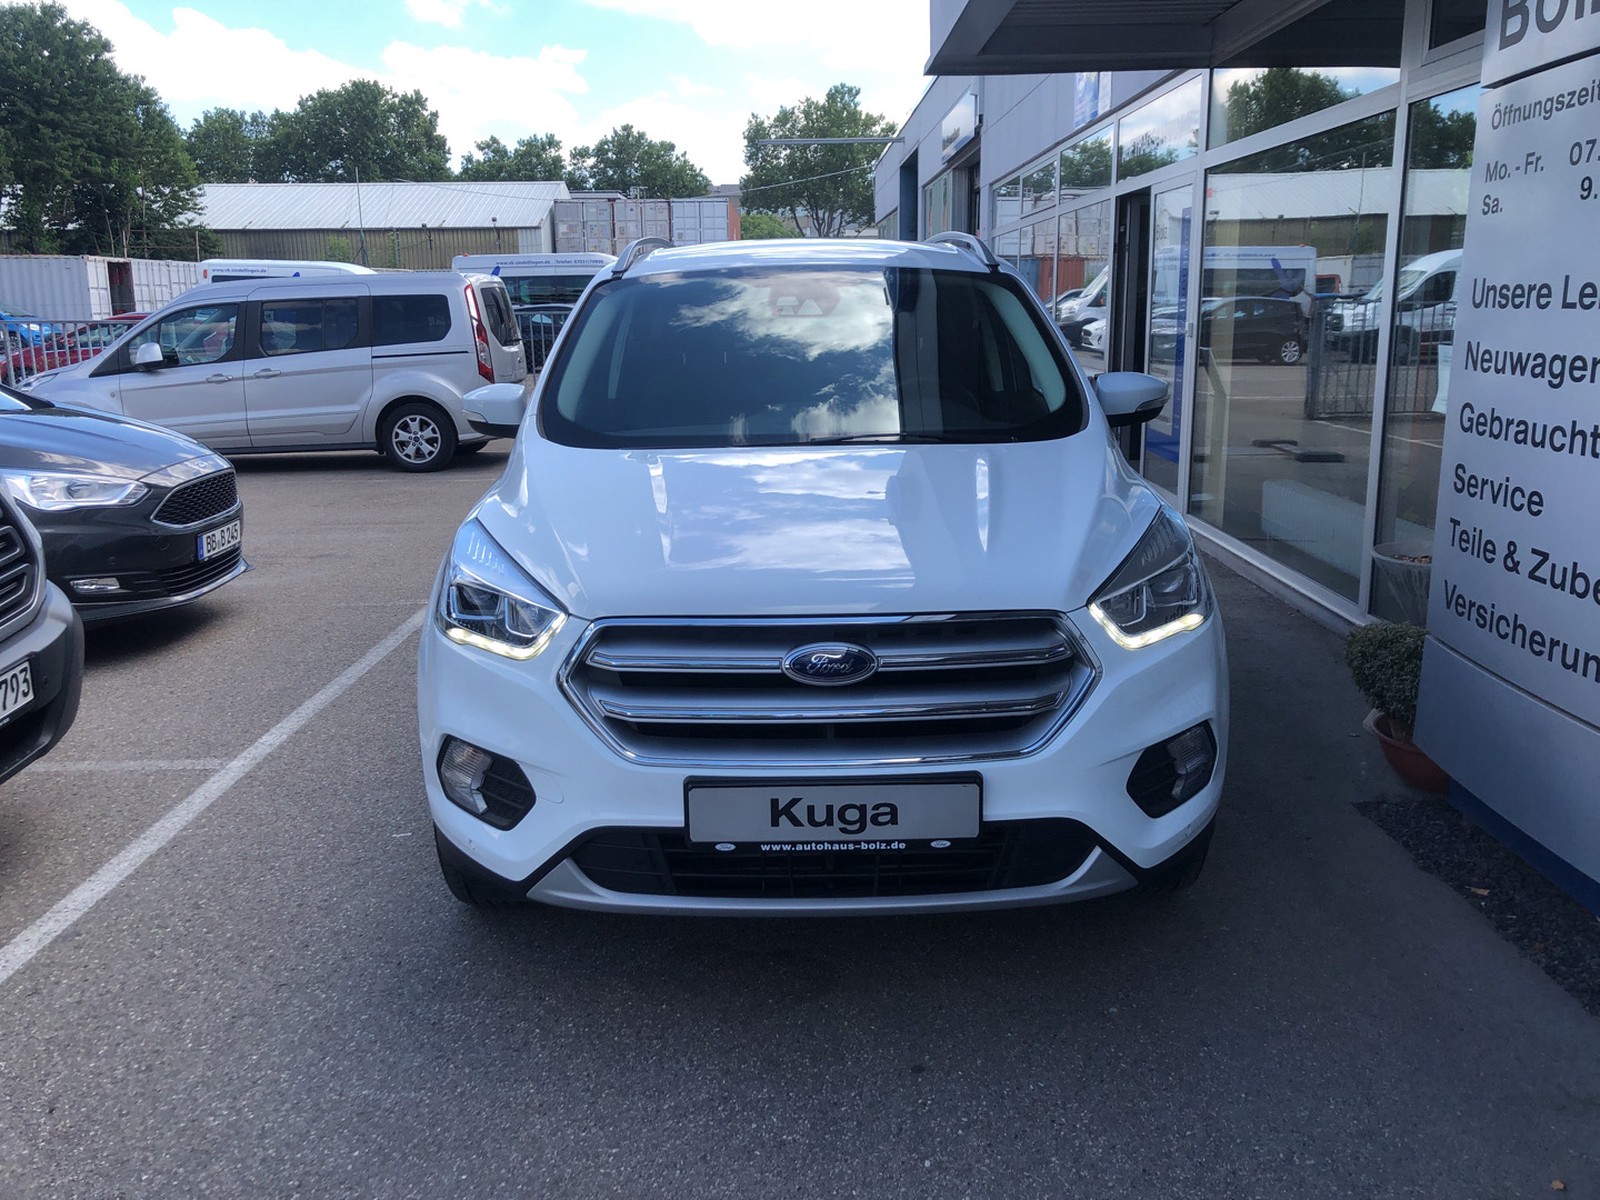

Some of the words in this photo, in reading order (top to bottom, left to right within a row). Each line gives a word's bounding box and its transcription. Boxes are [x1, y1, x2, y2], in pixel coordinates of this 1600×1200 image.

[1484, 162, 1511, 183] Mo.
[1524, 152, 1544, 175] Fr.
[1482, 194, 1503, 216] Sa.
[1580, 175, 1598, 200] 9.
[1472, 277, 1553, 310] Unsere
[1561, 274, 1600, 311] Le
[1459, 402, 1600, 459] Gebraucht
[1453, 463, 1545, 517] Service
[206, 532, 217, 554] BB
[1450, 516, 1497, 564] Teile
[1503, 540, 1521, 575] &
[1443, 579, 1600, 684] Versicherun
[806, 653, 855, 674] Ford
[0, 666, 31, 711] 793
[769, 796, 899, 836] Kuga
[760, 840, 907, 852] www.autohaus-bolz.de
